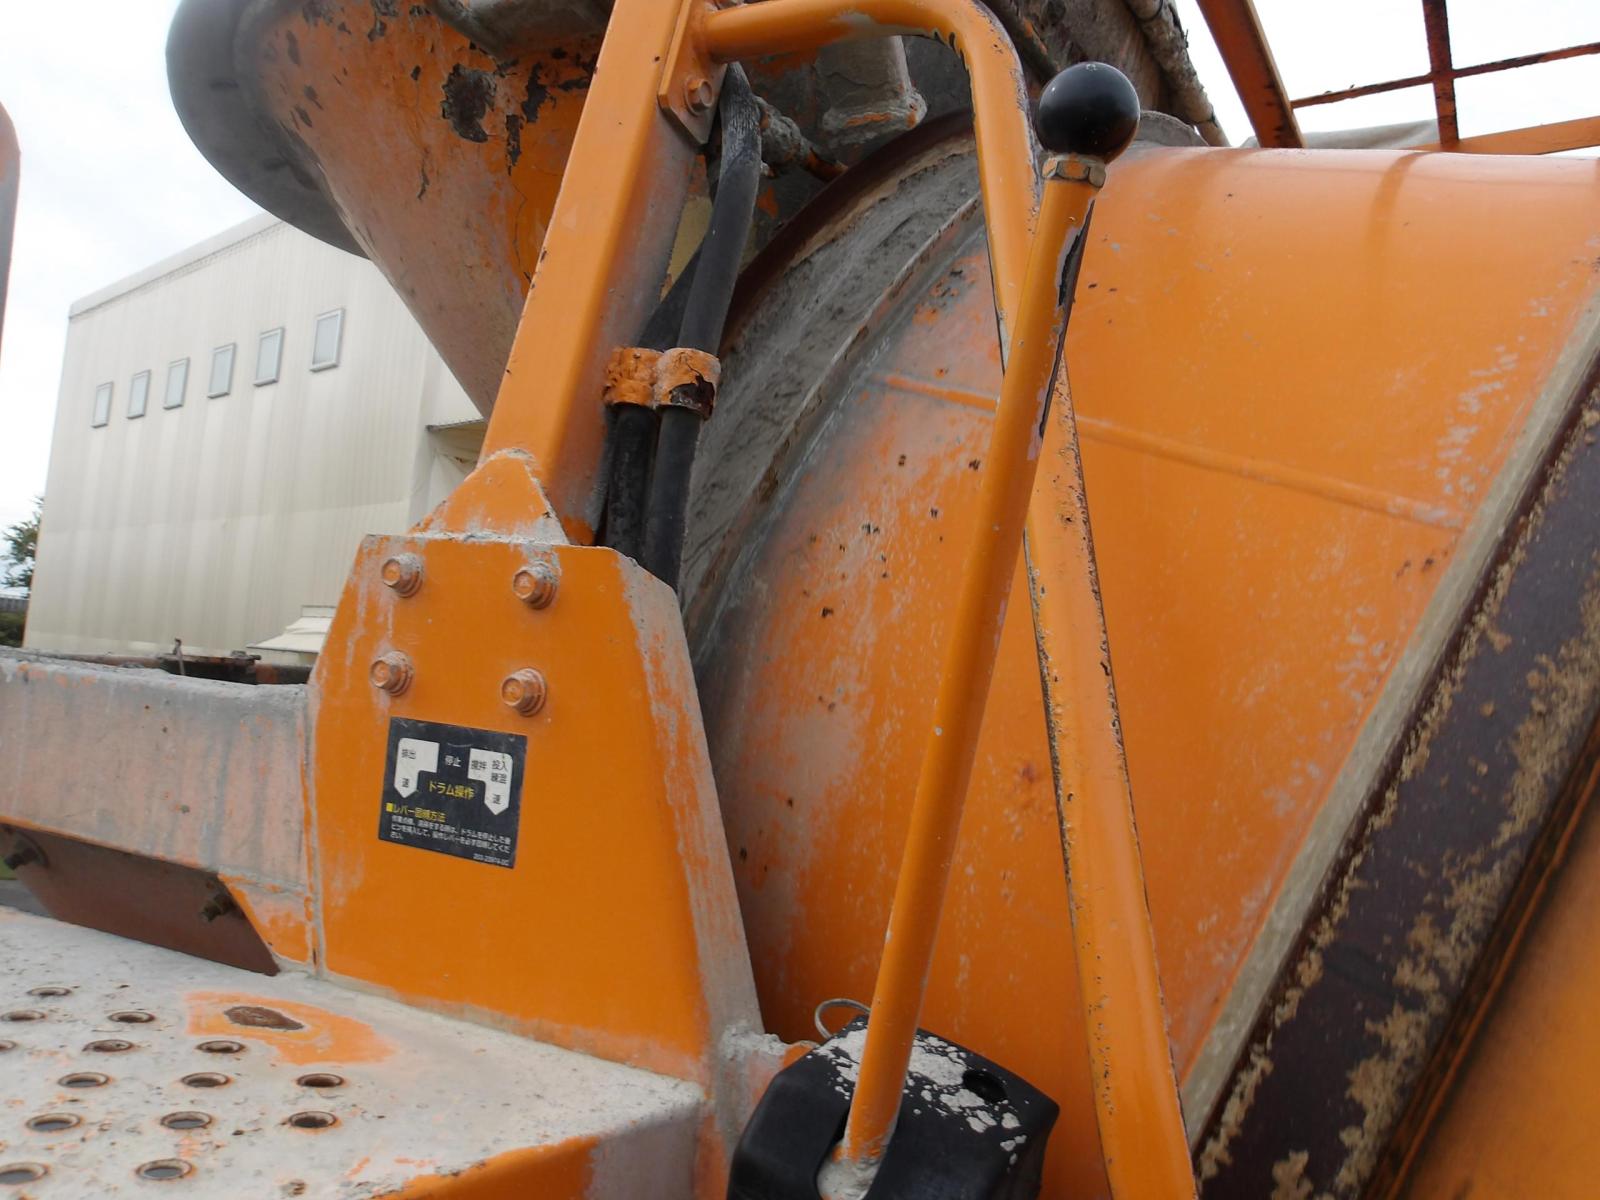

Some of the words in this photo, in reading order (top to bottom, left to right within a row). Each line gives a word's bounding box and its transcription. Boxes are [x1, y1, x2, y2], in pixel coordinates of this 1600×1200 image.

[444, 755, 462, 768] 停止
[491, 759, 508, 772] 投入
[428, 780, 476, 800] ドラム操作
